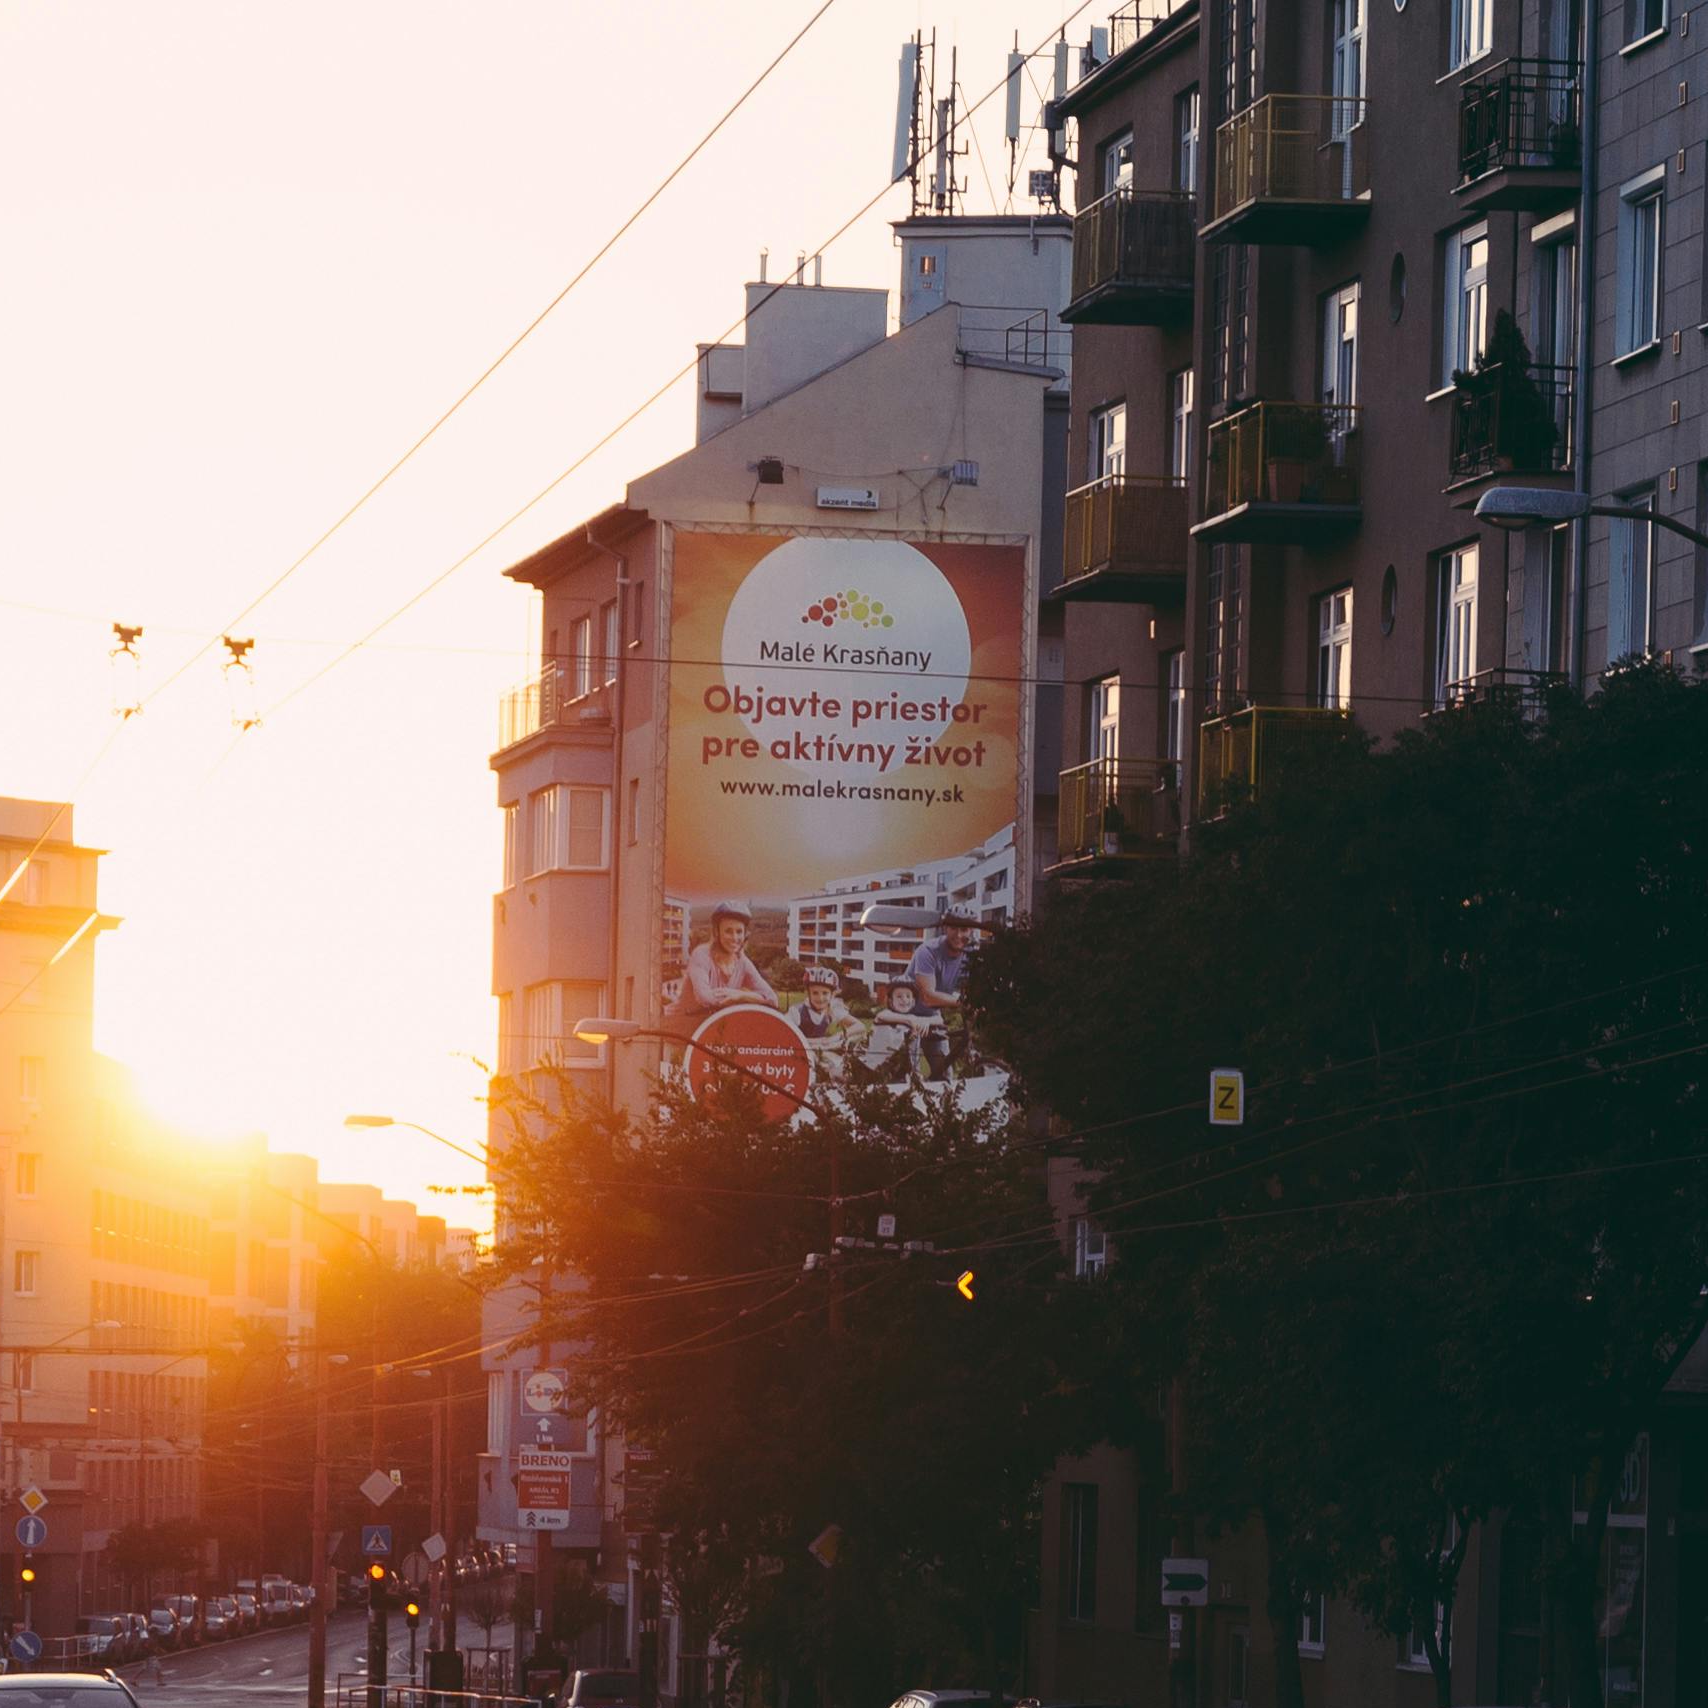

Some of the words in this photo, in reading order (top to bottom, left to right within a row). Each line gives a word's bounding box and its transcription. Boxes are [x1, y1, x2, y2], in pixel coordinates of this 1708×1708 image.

[760, 641, 815, 662] Malé
[824, 643, 932, 672] Krasňany
[703, 684, 841, 723] Objavte
[852, 691, 988, 728] priestor
[701, 735, 760, 765] pre
[770, 731, 896, 773] aktívny
[904, 736, 987, 768] život
[720, 779, 965, 807] www.malekrasnany.sk
[765, 1062, 795, 1079] byty
[1218, 1086, 1235, 1109] Z
[521, 1455, 570, 1467] BRENO
